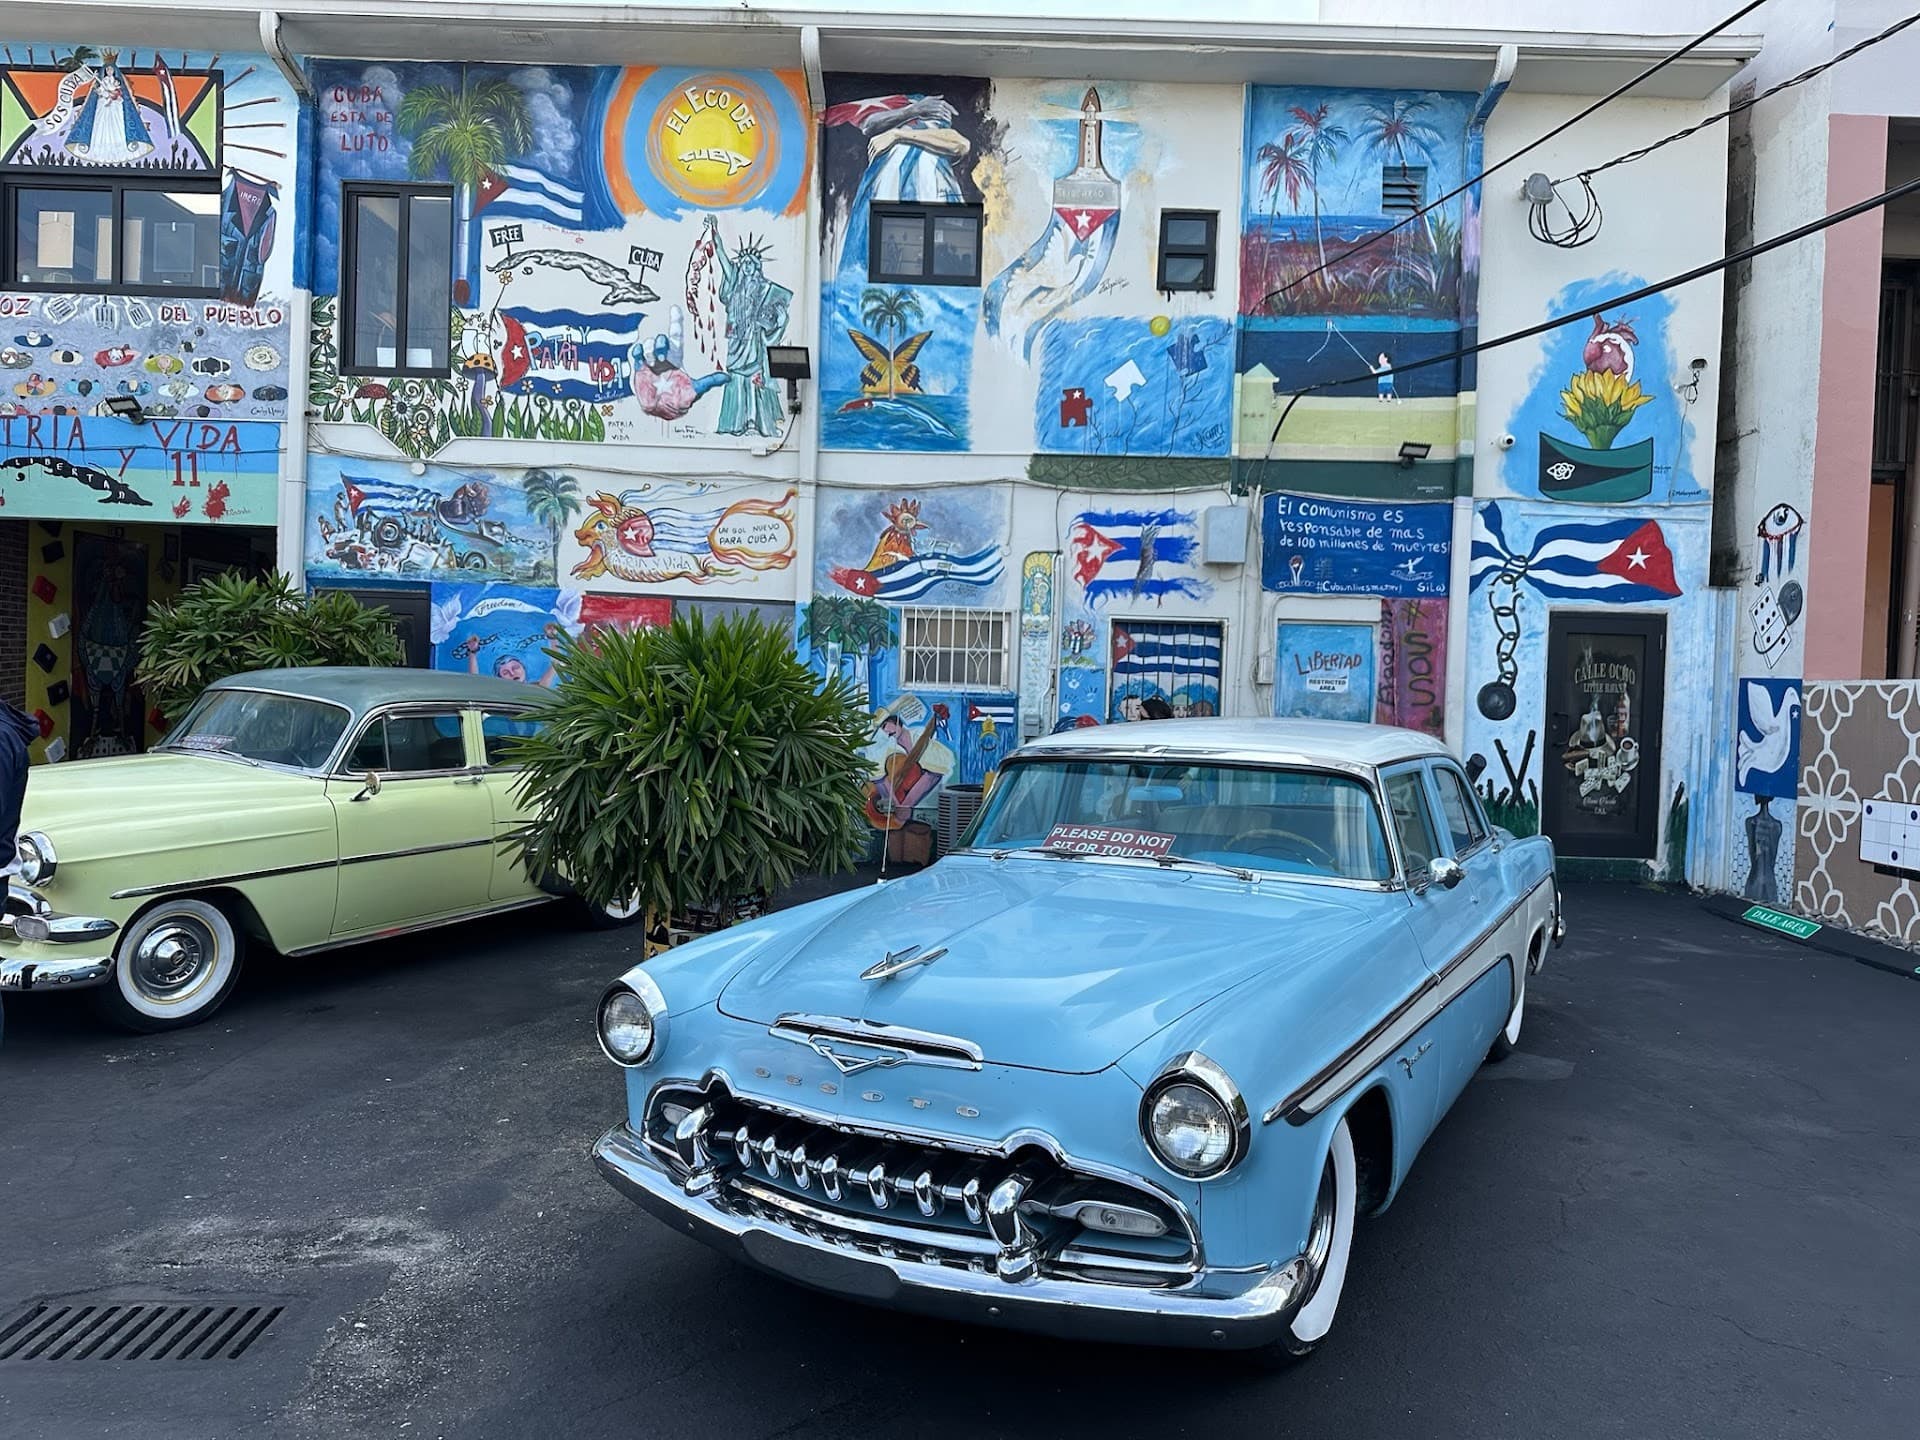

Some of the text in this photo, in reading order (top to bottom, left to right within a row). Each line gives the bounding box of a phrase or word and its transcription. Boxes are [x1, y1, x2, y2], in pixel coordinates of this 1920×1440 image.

[46, 73, 81, 130] SOS CUBA
[334, 86, 383, 103] CUBA
[331, 111, 394, 123] ESTA DE
[666, 86, 756, 135] EL ECO DE
[341, 133, 388, 152] LUTO
[493, 227, 521, 242] FREE
[631, 250, 660, 269] CUBA
[161, 306, 191, 322] DEL
[206, 306, 282, 326] PUEBLO
[608, 420, 633, 428] PATRIA
[119, 449, 135, 477] Y
[153, 421, 241, 453] VIDA
[15, 458, 125, 499] LIBERTAD
[171, 452, 200, 487] 11
[1278, 497, 1404, 523] El comunismo es
[753, 522, 780, 533] NUEVO
[1280, 519, 1425, 539] responsable de mas
[719, 534, 778, 545] PARA CUBA
[1280, 537, 1294, 547] de
[1297, 537, 1315, 548] 100
[1319, 538, 1368, 550] millones
[1372, 541, 1385, 551] de
[1294, 651, 1362, 675] LIBERTAD
[1574, 663, 1636, 685] CALLE OCHO
[1051, 827, 1171, 848] PLEASE DO NOT
[1051, 840, 1155, 857] SIT OR TOUCH
[1751, 910, 1808, 933] DALE AGUA
